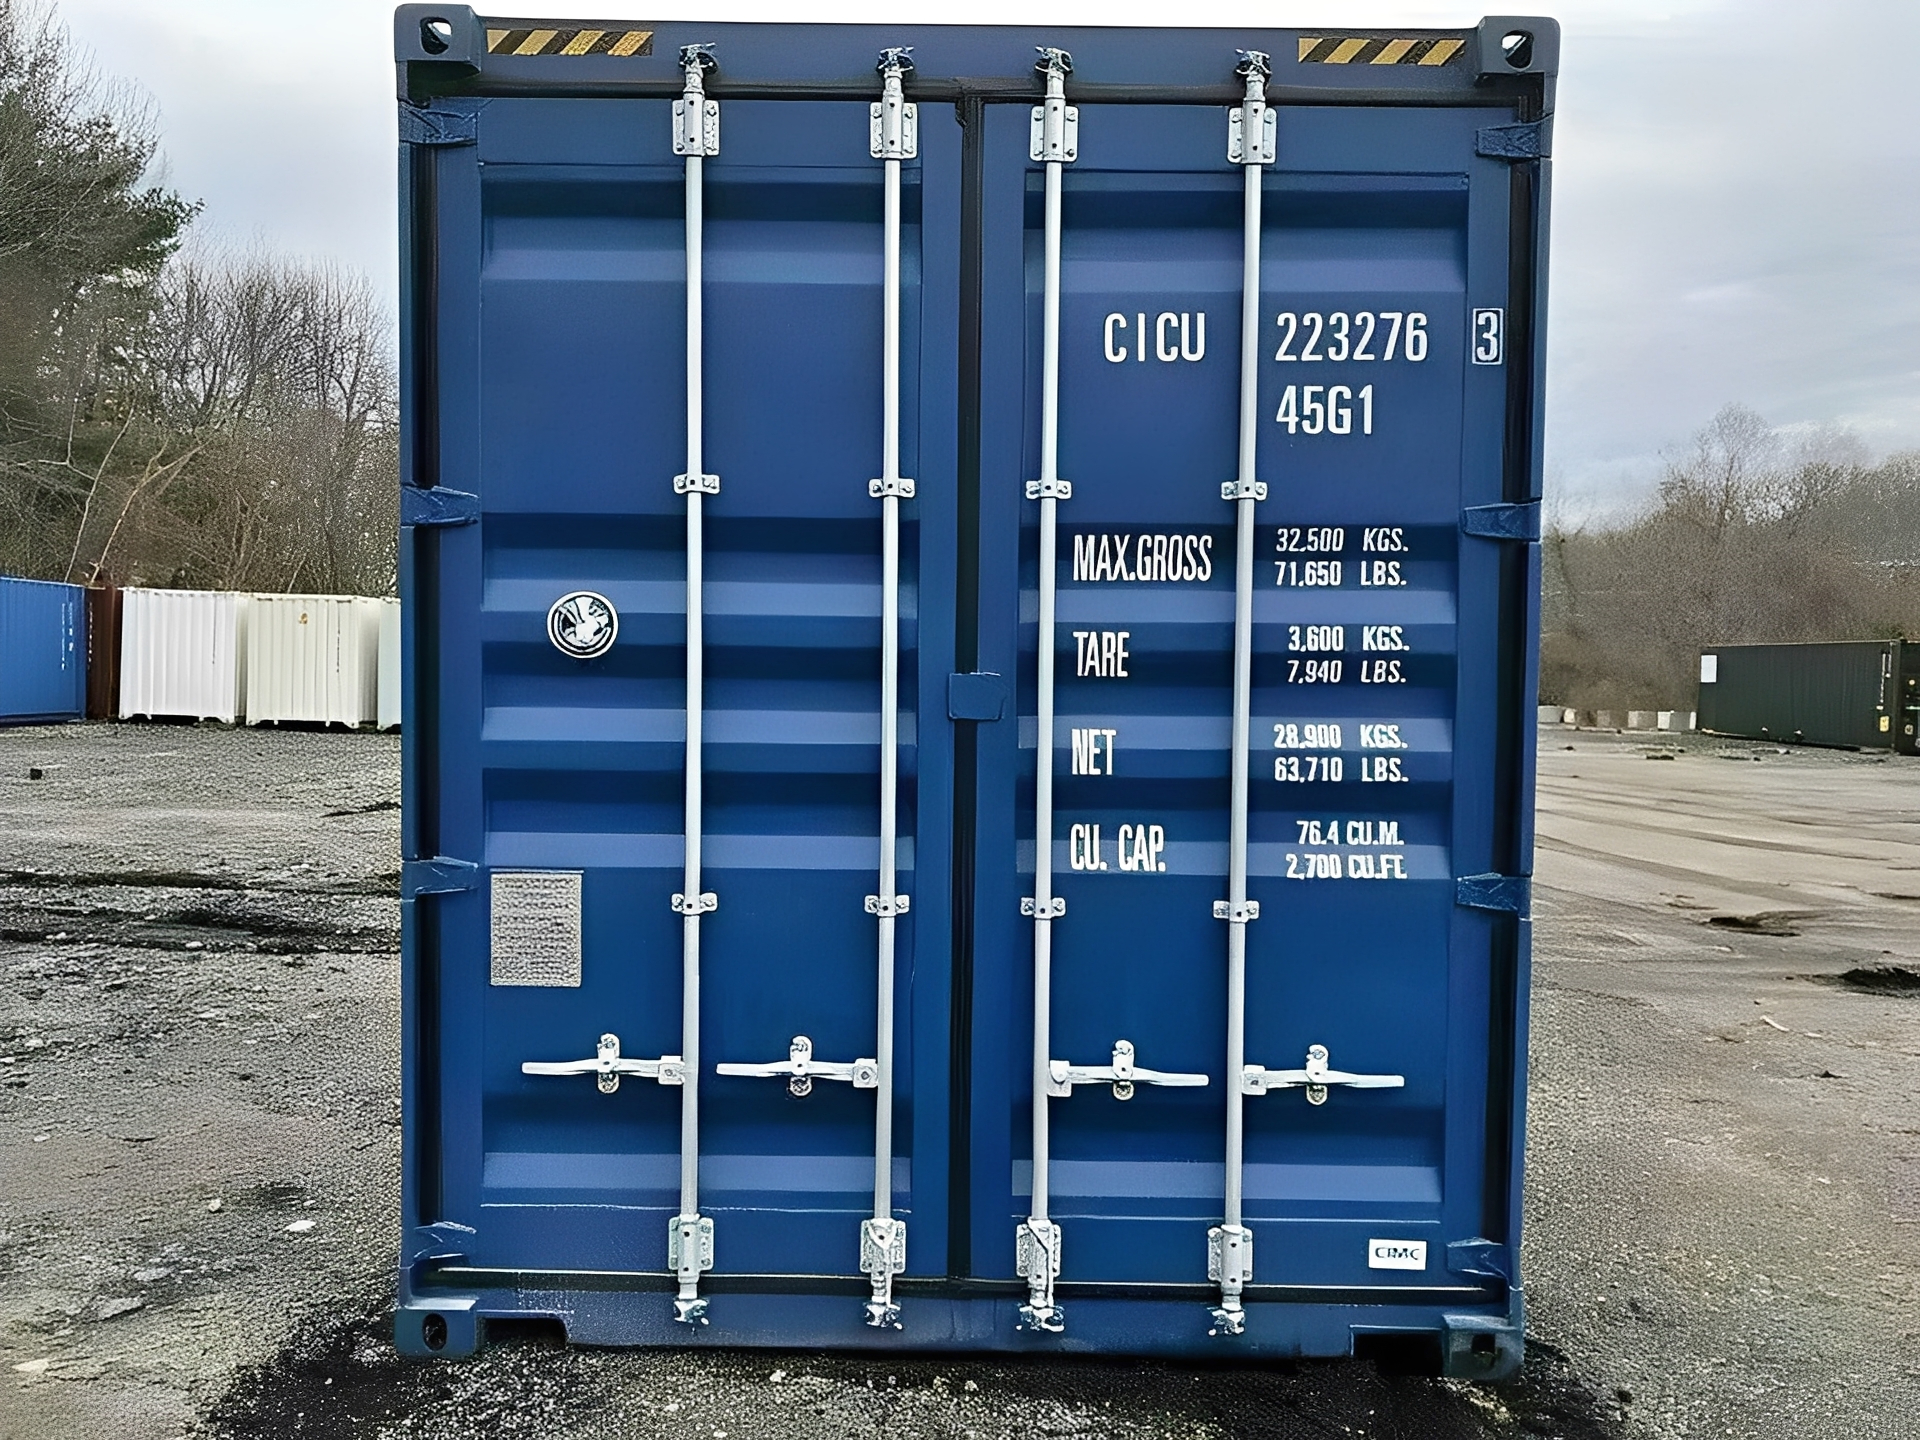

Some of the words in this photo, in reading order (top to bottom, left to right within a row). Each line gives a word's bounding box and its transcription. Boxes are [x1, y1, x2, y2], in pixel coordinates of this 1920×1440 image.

[1104, 312, 1206, 362] CICU
[1275, 311, 1428, 362] 223276
[1477, 311, 1498, 361] 3
[1276, 384, 1373, 435] 45G1
[1363, 528, 1409, 552] KGS.
[1073, 534, 1212, 582] MAX.GROSS
[1361, 561, 1407, 586] LBS.
[1363, 625, 1410, 651] KGS.
[1073, 631, 1130, 678] TARE
[1361, 660, 1407, 683] LBS.
[1360, 724, 1408, 749] KGS.
[1072, 729, 1116, 775] NET
[1361, 757, 1409, 782] LBS.
[1296, 820, 1339, 845] 76.4
[1346, 820, 1405, 845] CU.M.
[1070, 823, 1107, 870] CU.
[1118, 824, 1166, 872] CAP.
